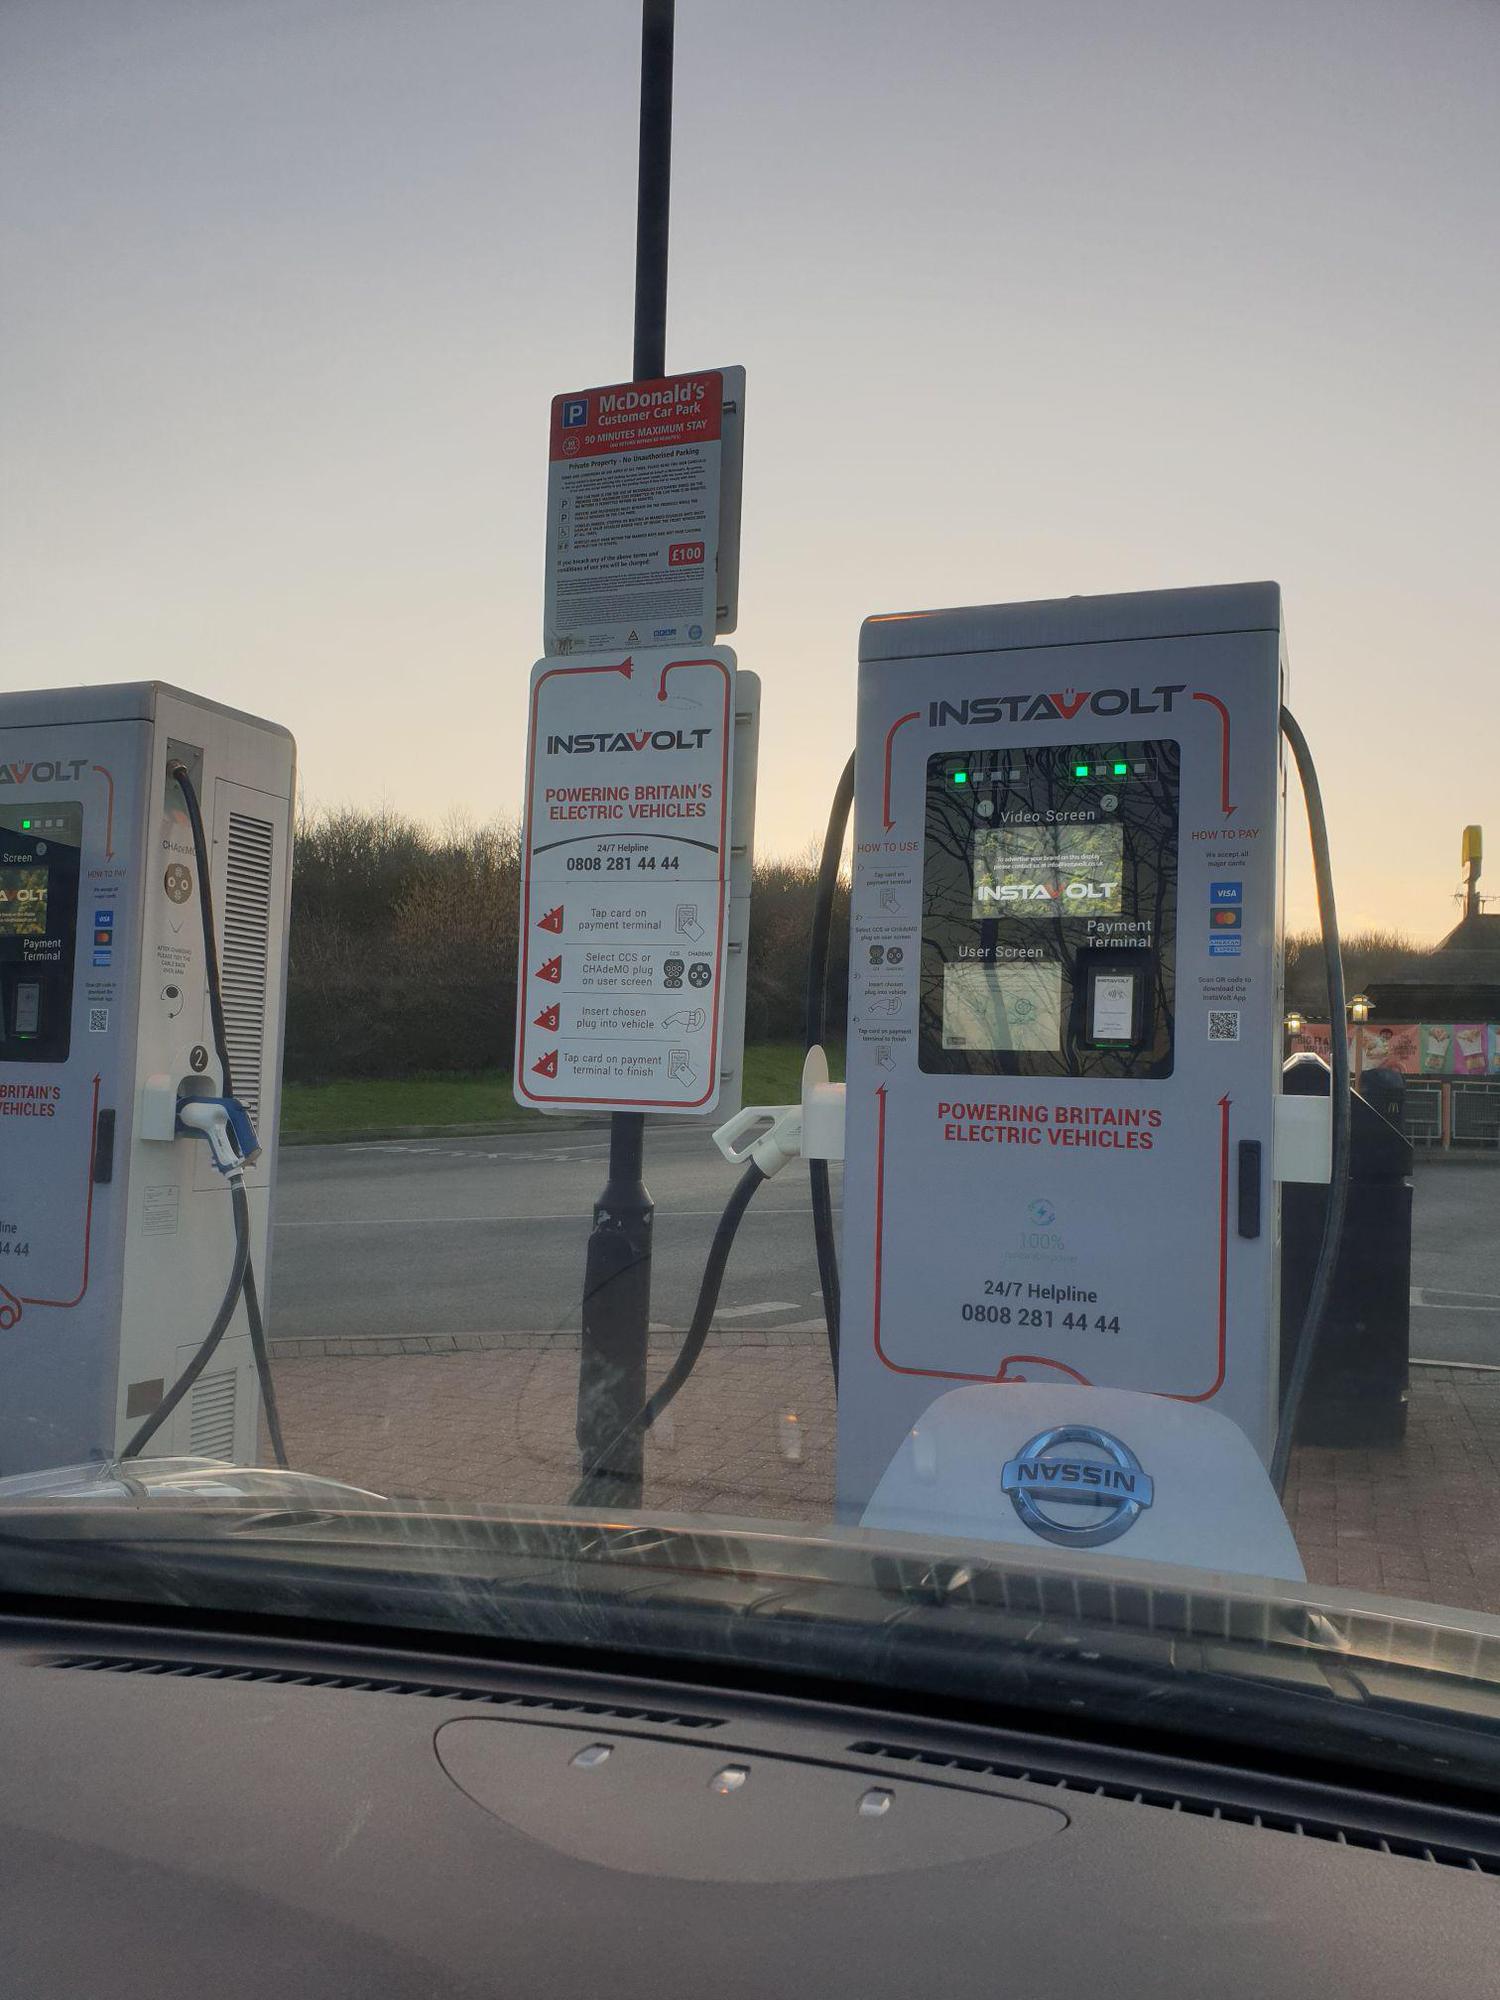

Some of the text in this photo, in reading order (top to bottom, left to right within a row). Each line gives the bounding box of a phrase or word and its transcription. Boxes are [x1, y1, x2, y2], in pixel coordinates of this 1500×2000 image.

[599, 382, 705, 413] McDonald's
[569, 405, 583, 424] P
[598, 402, 701, 426] Customer Car Park
[584, 419, 708, 445] 90 MINUTES MAXIMUM STAY
[569, 462, 589, 470] Private
[591, 458, 617, 468] Property
[622, 455, 632, 463] No
[633, 450, 674, 462] Unauthorised
[676, 448, 700, 457] Parking
[672, 547, 701, 561] £100
[928, 684, 1187, 728] INSTAVOLT
[547, 728, 712, 755] INSTAVOLT
[545, 783, 712, 803] POWERING BRITAIN'S
[550, 802, 706, 820] ELECTRIC VEHICLES
[1001, 809, 1095, 823] Video Screen
[1192, 828, 1259, 841] HOW TO PAY
[597, 843, 649, 854] 24/7 Helpline
[857, 841, 920, 853] HOW TO USE
[3, 852, 33, 863] Screen
[566, 855, 680, 871] 0808 281 44 44
[977, 879, 1119, 901] INSTAVOLT
[1217, 889, 1237, 897] VISA
[591, 908, 608, 919] Tap
[610, 908, 632, 918] card
[578, 919, 662, 931] payment terminal
[1087, 919, 1151, 935] Payment
[23, 938, 61, 951] Payment
[1087, 935, 1151, 948] Terminal
[23, 950, 61, 961] Terminal
[585, 952, 652, 963] Select CCS or
[958, 946, 1044, 959] User Screen
[550, 967, 558, 978] 2
[582, 964, 654, 977] CHAdeMO plug
[582, 977, 653, 986] on user screen
[582, 1006, 647, 1016] Insert chosen
[548, 1014, 556, 1025] 3
[576, 1018, 655, 1030] plug into vehicle
[195, 1049, 203, 1067] 2
[563, 1053, 662, 1067] Tap card on payment
[573, 1065, 654, 1077] terminal to finish
[0, 1084, 61, 1100] BRITAIN'S
[937, 1102, 1162, 1128] POWERING BRITAIN'S
[944, 1124, 1154, 1150] ELECTRIC VEHICLES
[1020, 1231, 1064, 1251] 100%
[14, 1241, 30, 1257] 44
[984, 1279, 1098, 1304] 24/7 Helpline
[961, 1303, 1120, 1334] 0808 281 44 44
[1017, 1462, 1135, 1493] NISSAN
